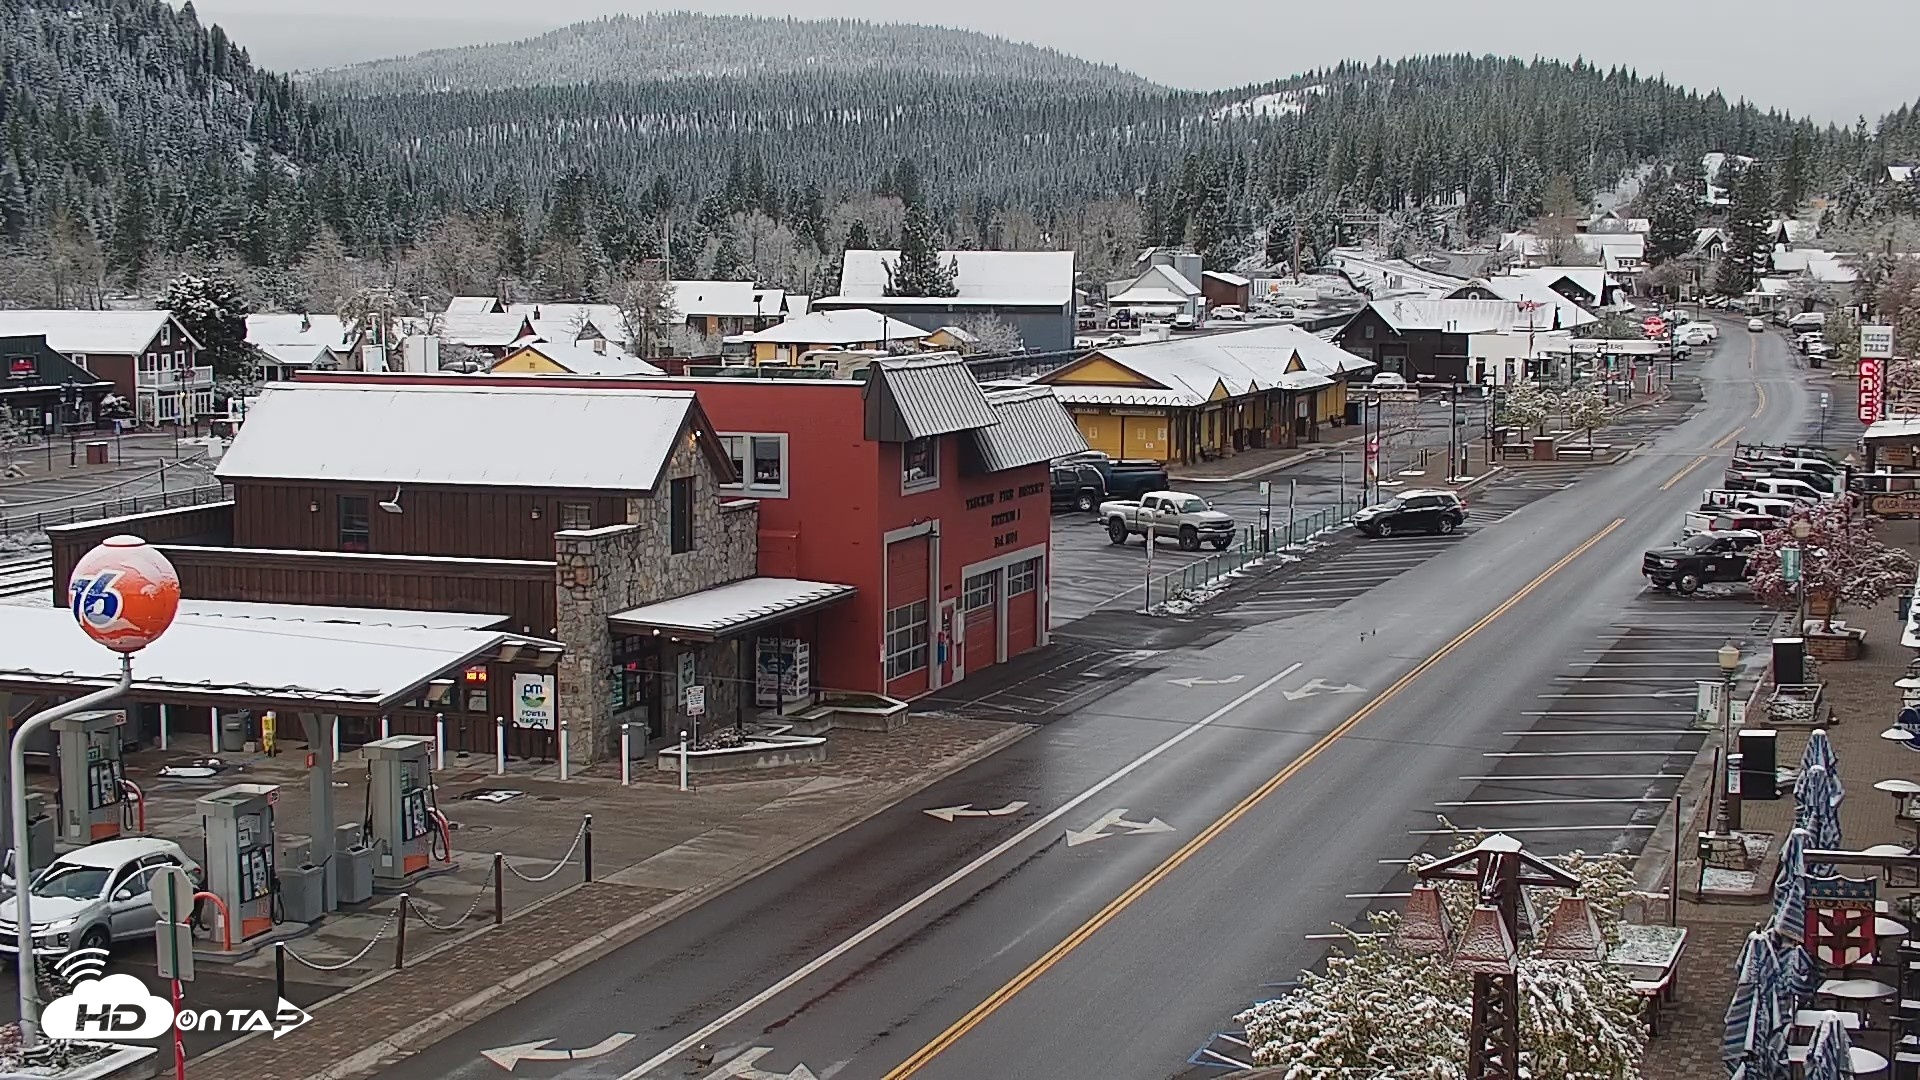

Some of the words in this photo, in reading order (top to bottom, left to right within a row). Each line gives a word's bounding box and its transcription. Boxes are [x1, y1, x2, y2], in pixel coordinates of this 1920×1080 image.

[1860, 362, 1875, 420] CAFE
[71, 569, 123, 628] 76
[523, 683, 543, 697] pm
[521, 709, 547, 717] POWER
